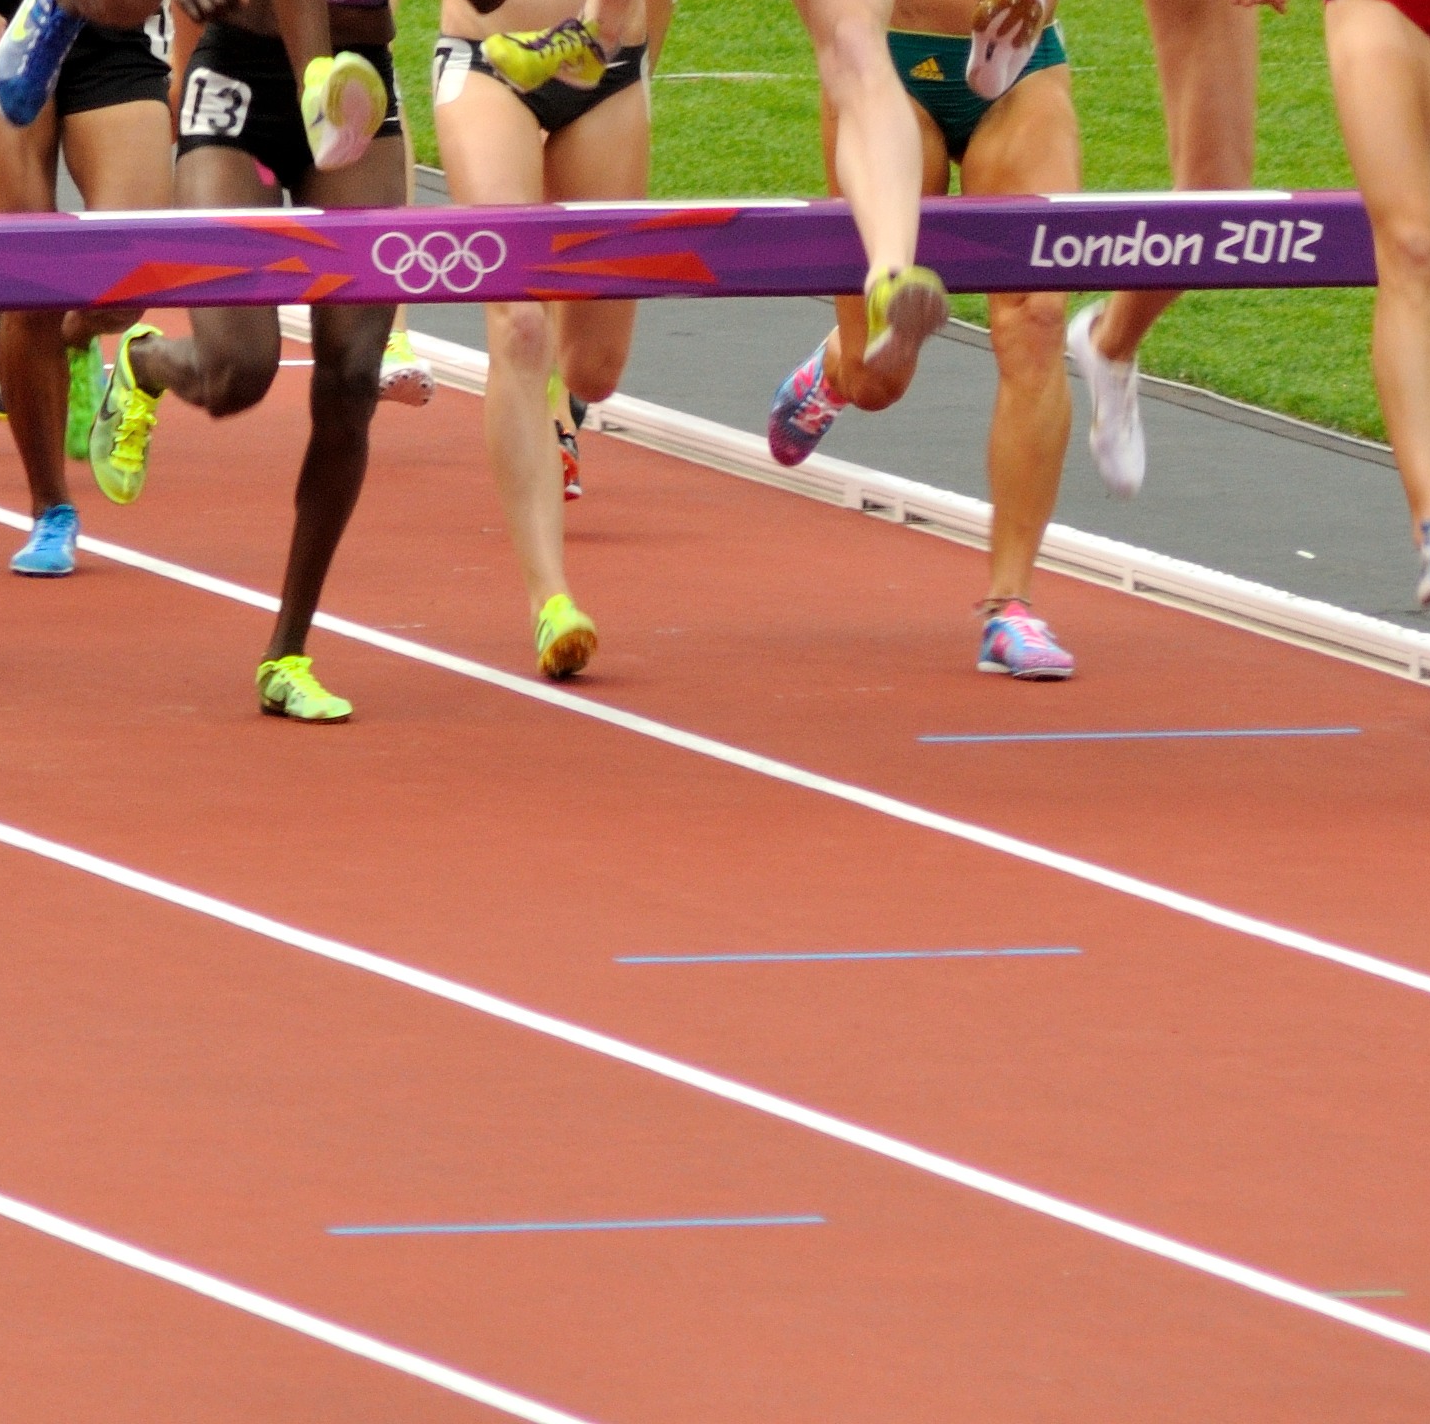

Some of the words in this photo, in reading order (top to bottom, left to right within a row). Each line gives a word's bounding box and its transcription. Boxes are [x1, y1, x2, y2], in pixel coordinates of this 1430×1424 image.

[190, 77, 244, 135] 13
[1029, 220, 1205, 268] London
[1213, 220, 1324, 265] 2012
